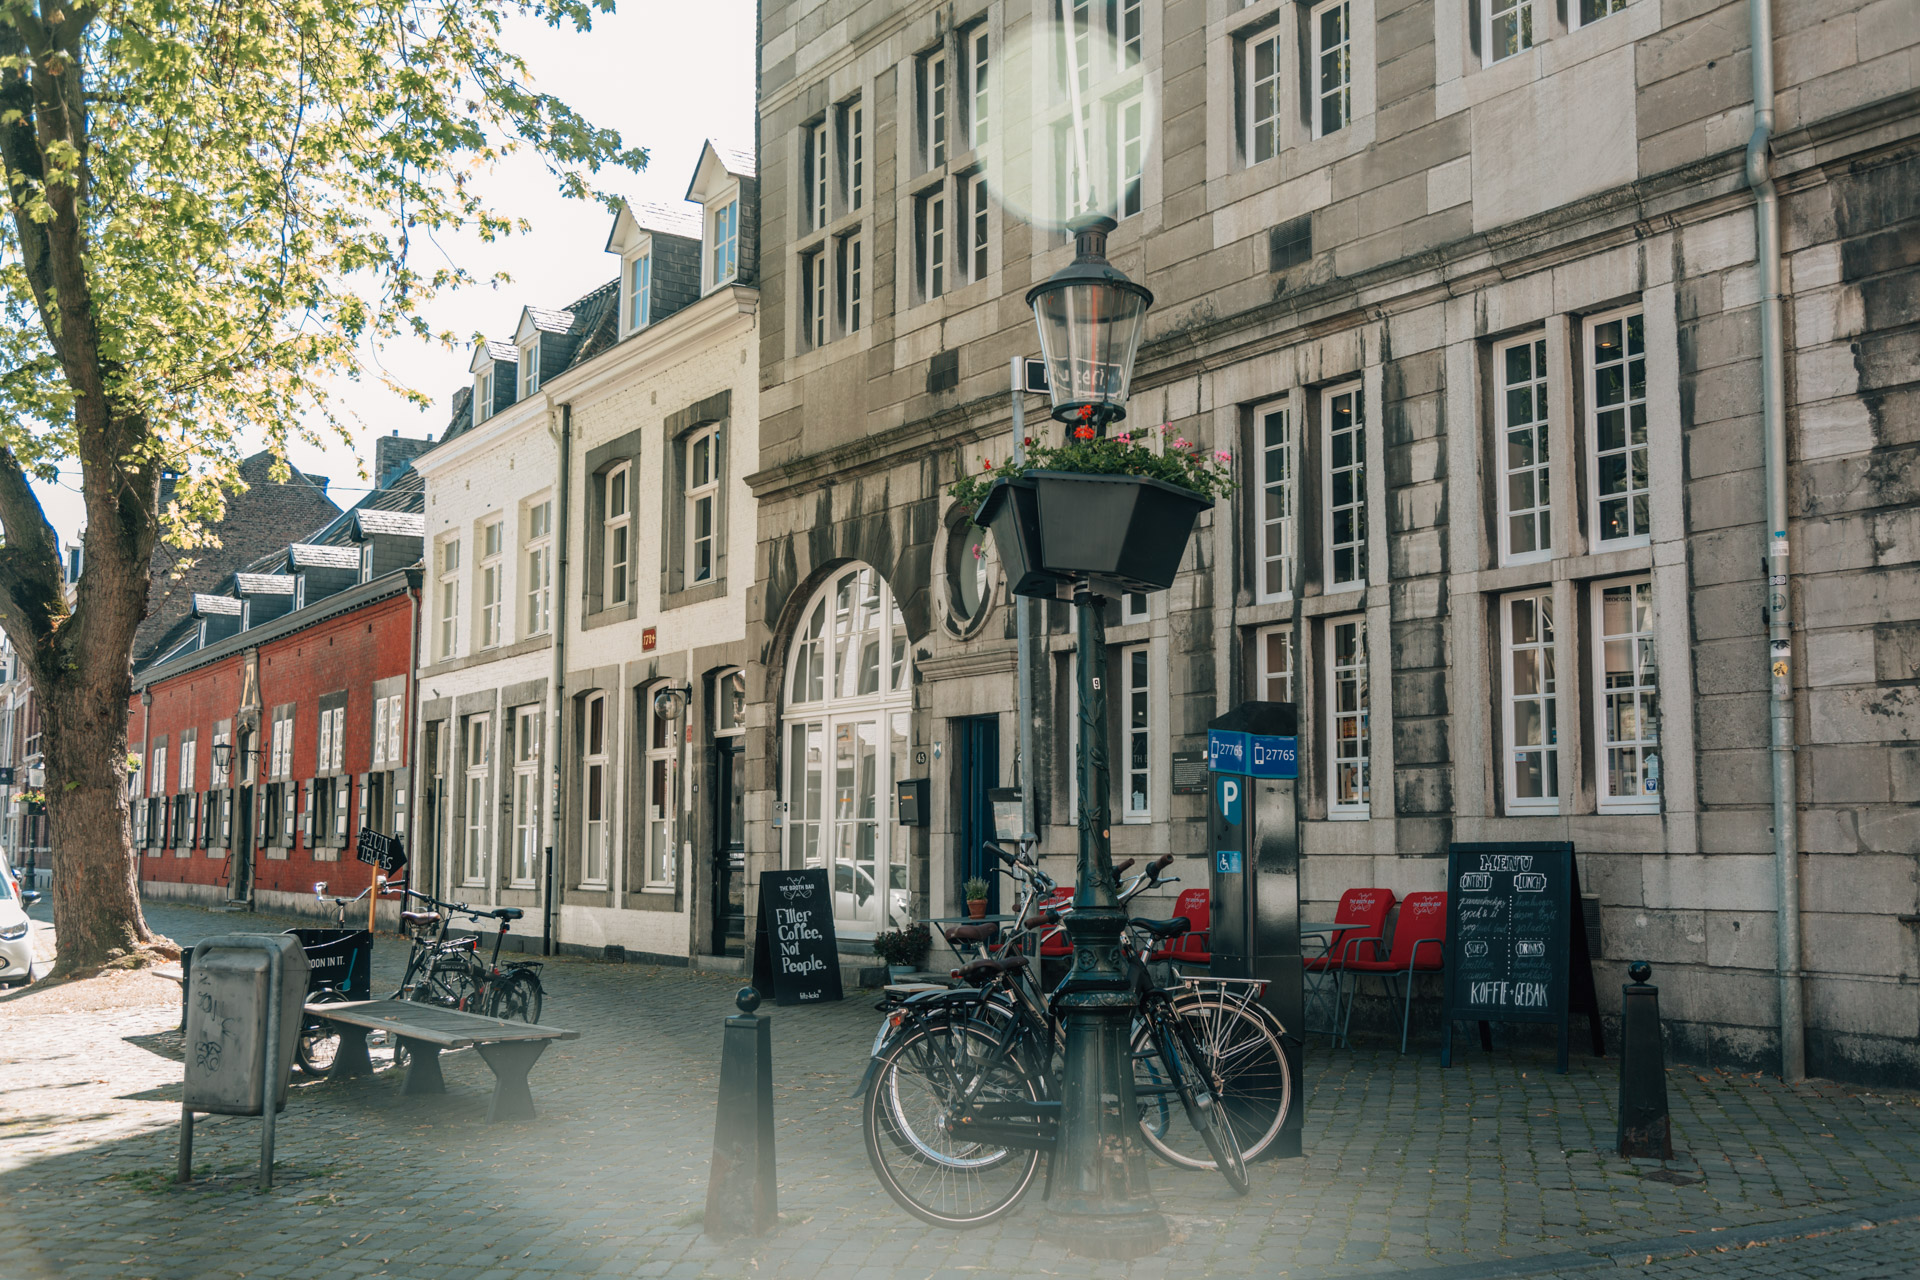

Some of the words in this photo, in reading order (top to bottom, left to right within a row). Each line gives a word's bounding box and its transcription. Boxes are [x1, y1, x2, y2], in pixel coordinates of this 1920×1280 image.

[1220, 744, 1242, 757] 27765
[1266, 749, 1294, 761] 27765
[1224, 781, 1238, 816] P
[1480, 854, 1533, 872] MENU
[1518, 876, 1542, 889] LUNCH
[776, 908, 812, 925] Filter
[778, 922, 823, 941] Coffee,
[780, 941, 800, 956] Not
[1468, 944, 1484, 954] SOEP
[1519, 943, 1543, 954] DRINKS
[309, 957, 326, 968] OON
[327, 956, 335, 967] IN
[782, 953, 827, 976] People.
[1471, 980, 1509, 1004] KOFFIE
[1515, 982, 1548, 1007] GEBAK
